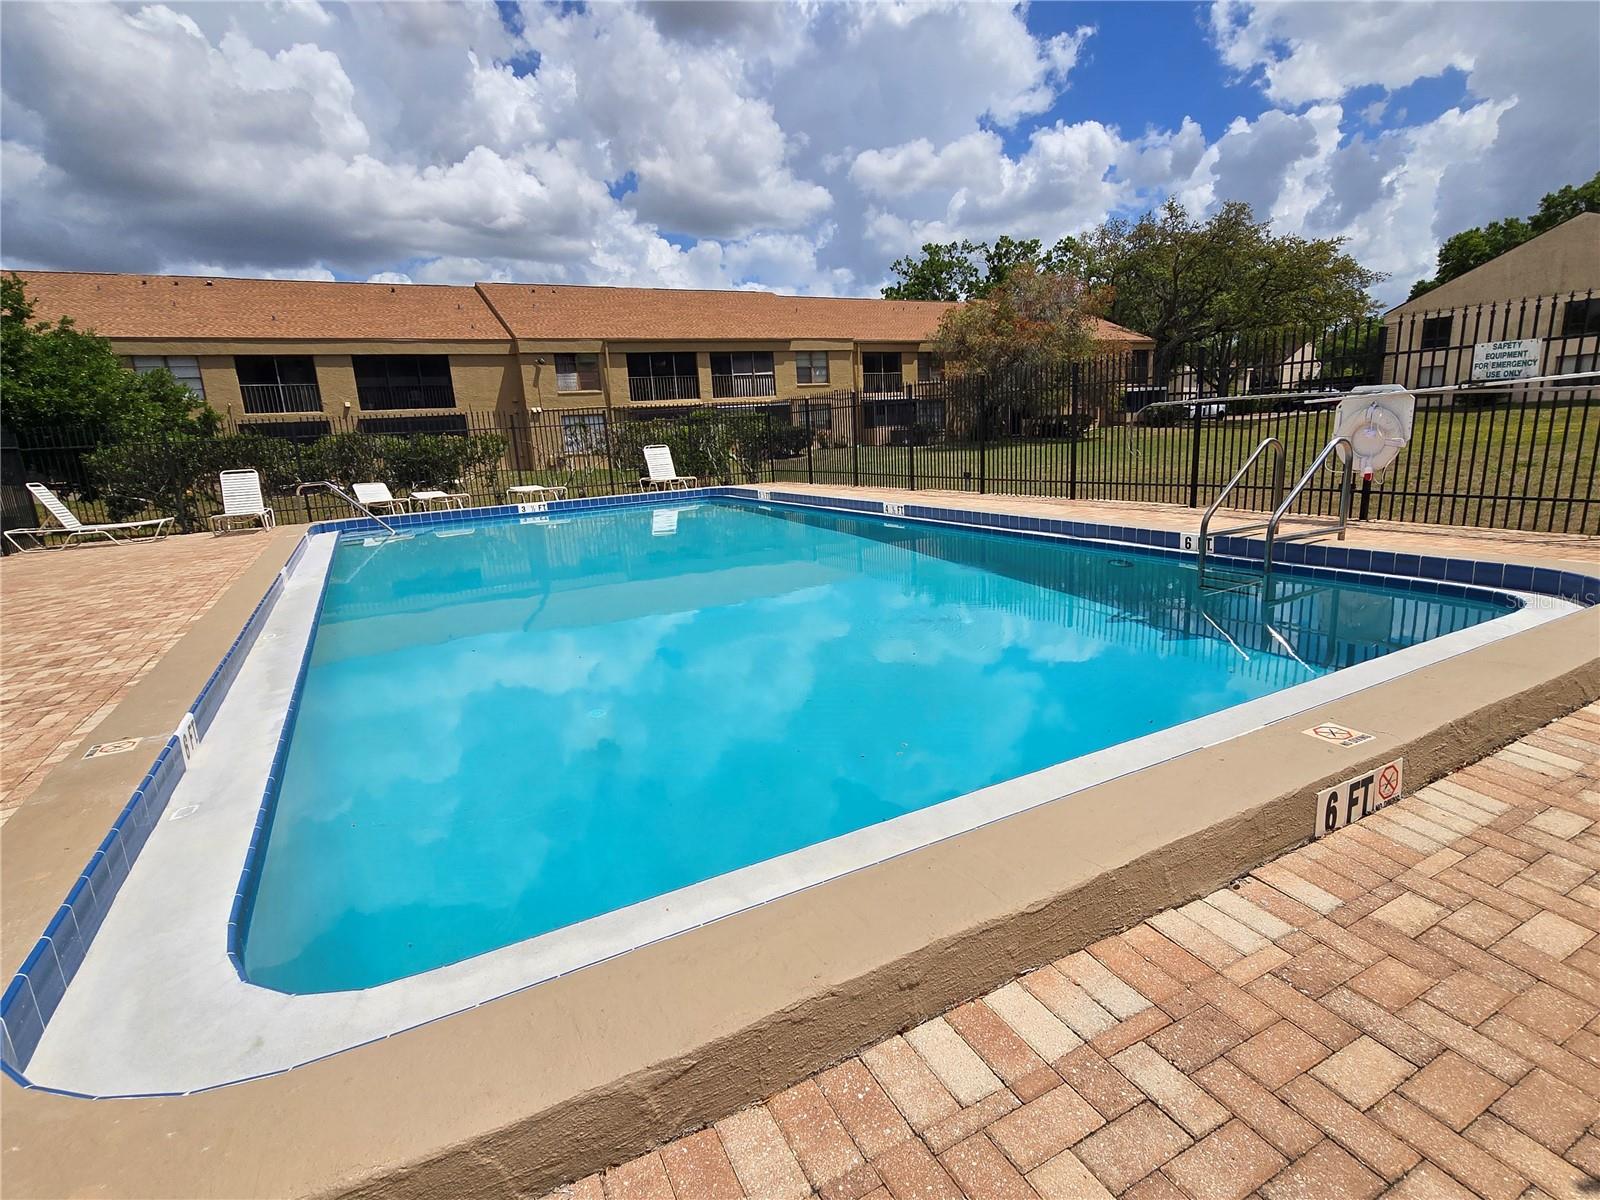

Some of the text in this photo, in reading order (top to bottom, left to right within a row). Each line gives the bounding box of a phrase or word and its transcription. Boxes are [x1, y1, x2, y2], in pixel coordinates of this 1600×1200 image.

[1492, 341, 1523, 350] SAFETY
[1485, 350, 1528, 360] EQUIPMENT
[1474, 359, 1538, 370] FOR EMERGENCY
[1486, 369, 1523, 378] USE ONLY
[1184, 536, 1192, 550] 6
[183, 733, 191, 761] 6
[1325, 790, 1339, 832] 6
